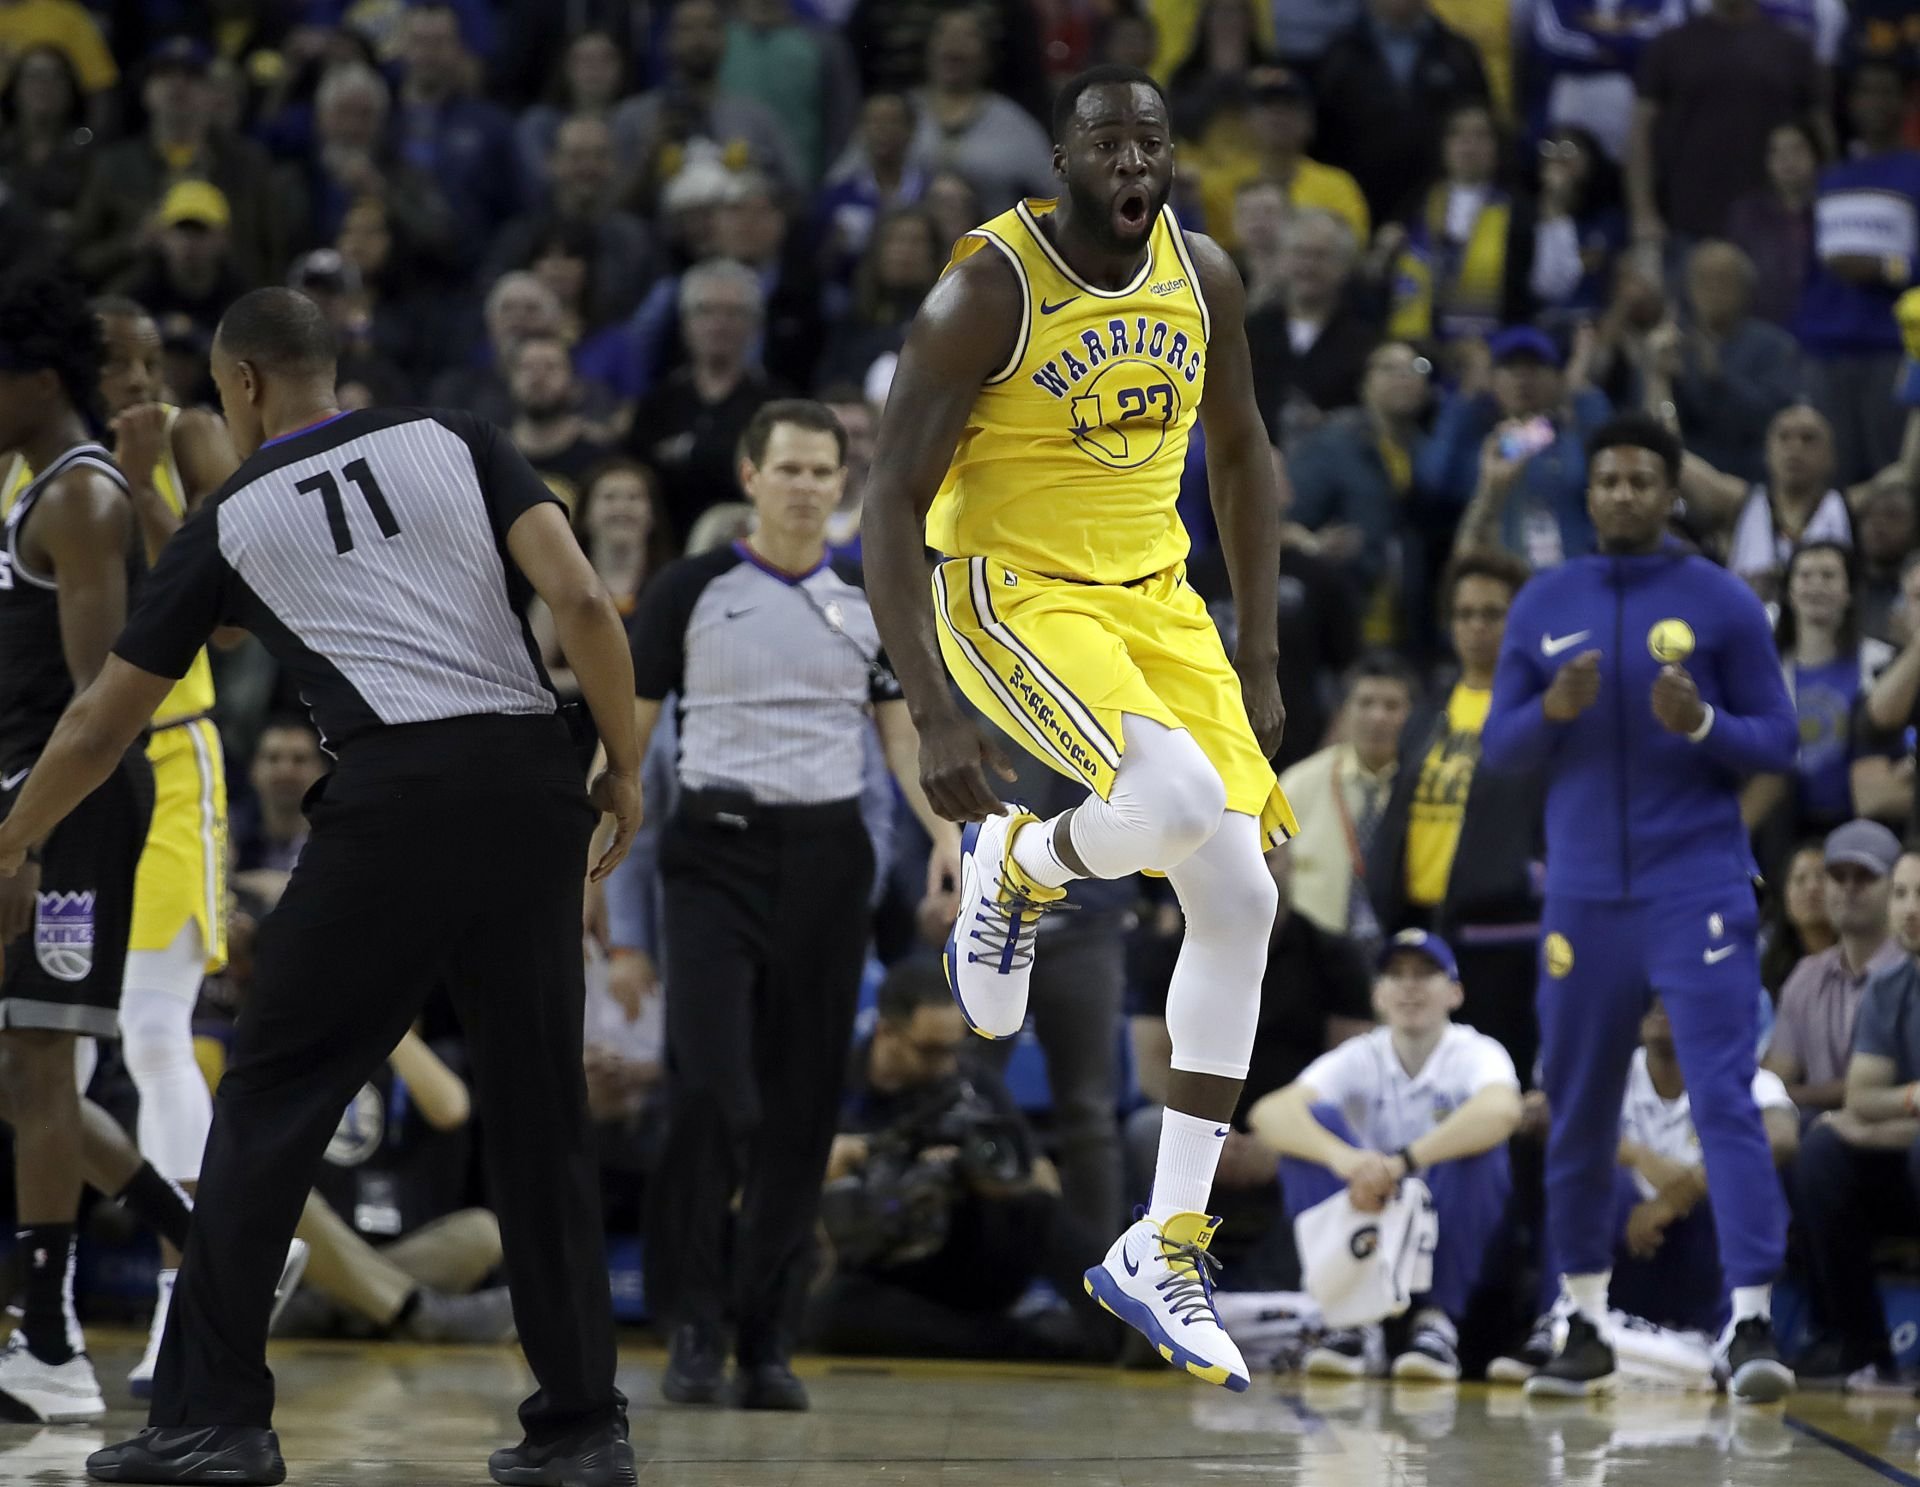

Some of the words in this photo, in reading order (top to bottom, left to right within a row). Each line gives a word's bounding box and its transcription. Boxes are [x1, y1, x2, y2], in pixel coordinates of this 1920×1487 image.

[1032, 316, 1201, 398] WARRIORS
[1117, 383, 1173, 422] 23
[294, 457, 402, 555] 71
[1009, 664, 1097, 776] WARRIORS
